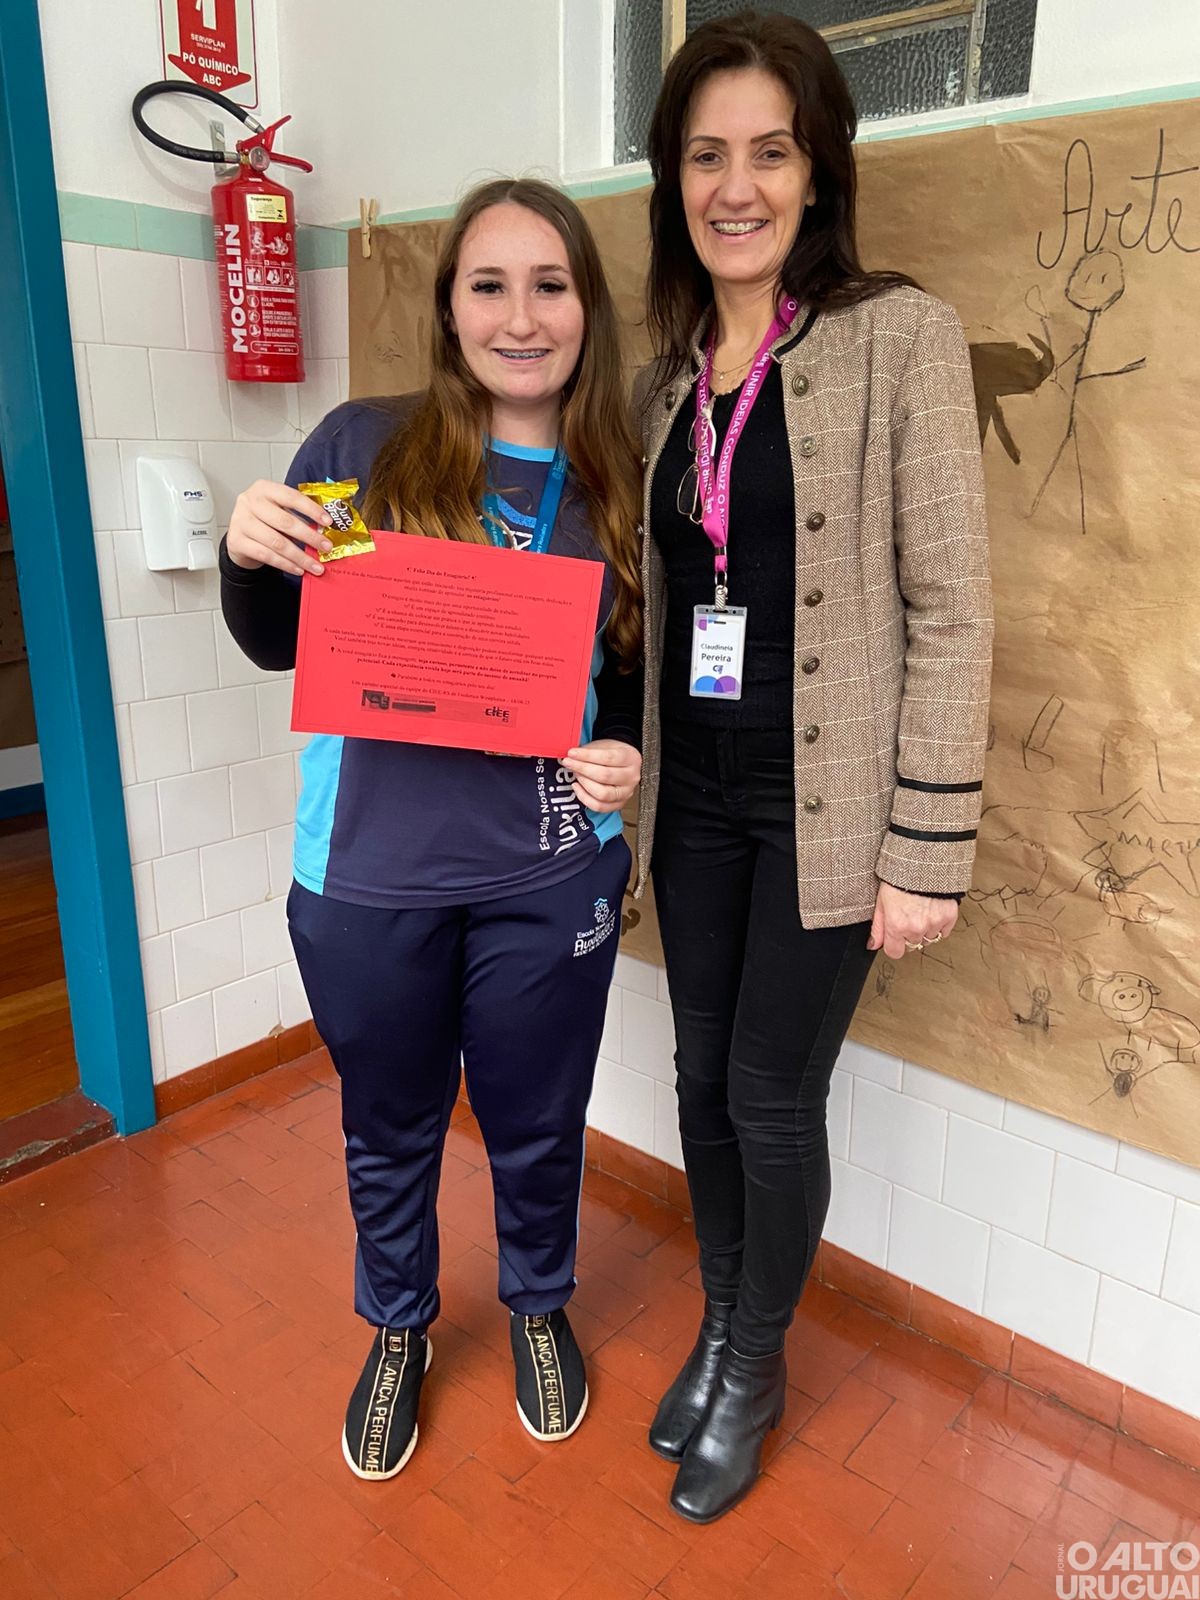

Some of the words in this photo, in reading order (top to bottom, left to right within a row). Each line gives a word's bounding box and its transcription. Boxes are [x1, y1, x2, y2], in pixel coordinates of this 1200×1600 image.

[191, 33, 226, 49] SERVIPLAN
[182, 52, 196, 65] PÓ
[198, 57, 238, 76] QUÍMICO
[202, 73, 222, 86] ABC
[1037, 128, 1200, 269] Arte
[224, 224, 248, 354] MOCELIN
[744, 370, 762, 397] UNIR
[730, 399, 749, 435] IDEIAS
[718, 438, 734, 491] CONDUZ
[323, 503, 348, 532] Branco
[334, 498, 354, 526] Ouro
[701, 652, 732, 662] Pereira
[538, 776, 550, 814] Nossa
[540, 817, 550, 850] Escola
[544, 1369, 562, 1434] PERFUME
[366, 1406, 394, 1473] PERFUME
